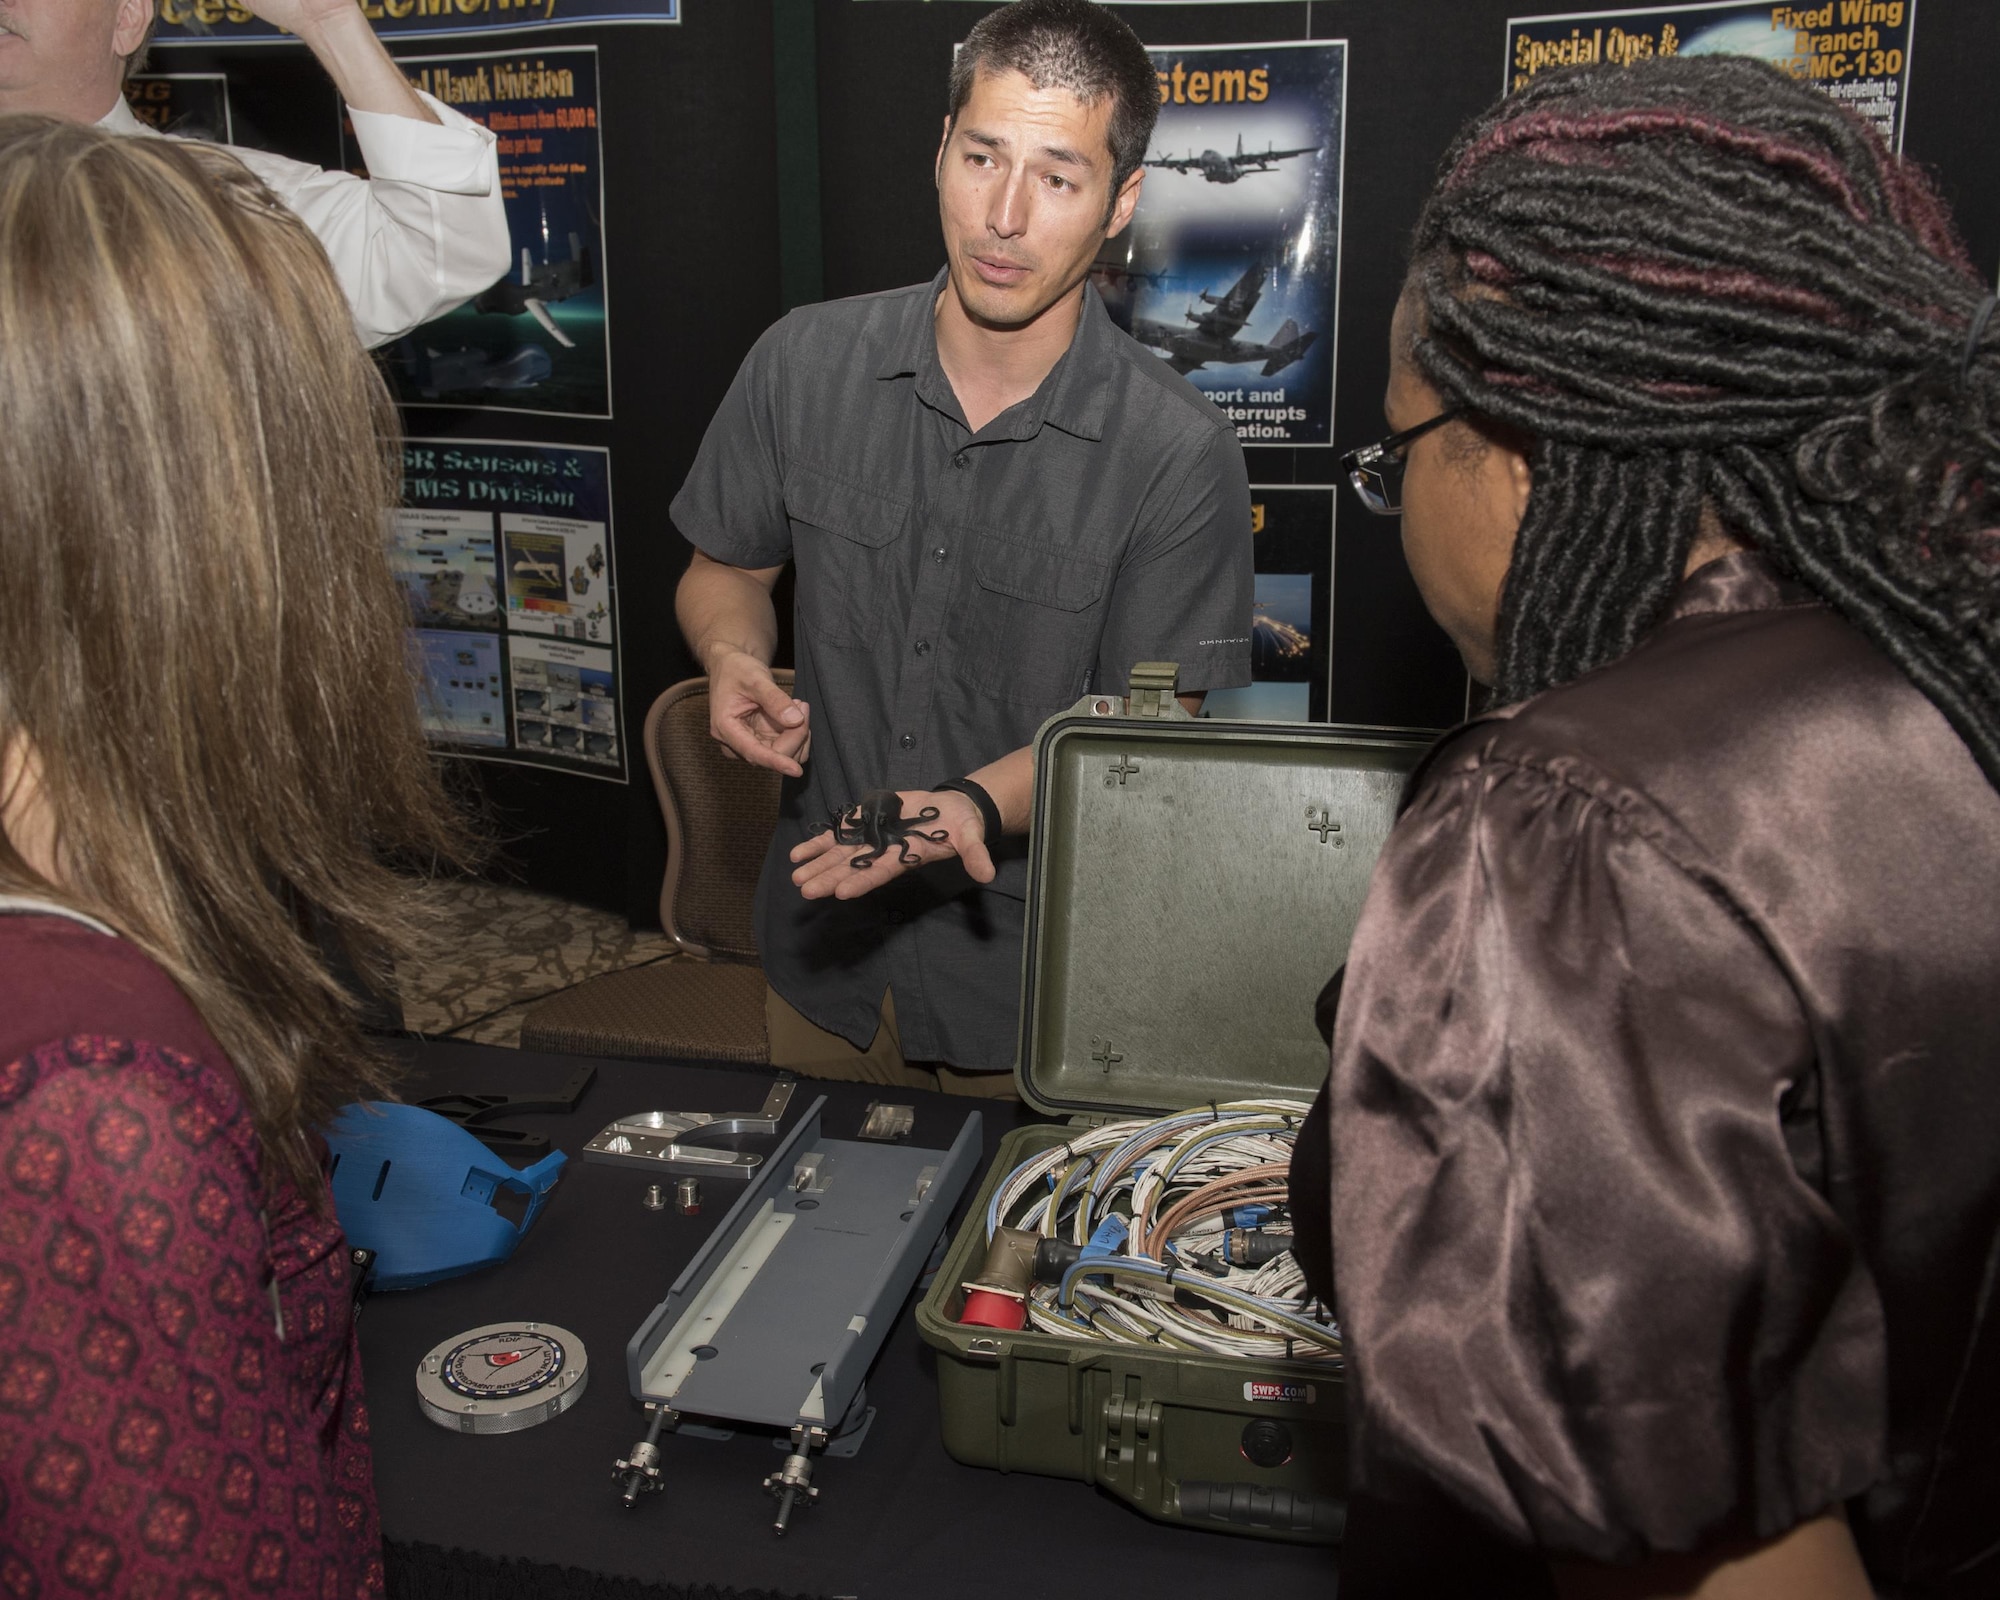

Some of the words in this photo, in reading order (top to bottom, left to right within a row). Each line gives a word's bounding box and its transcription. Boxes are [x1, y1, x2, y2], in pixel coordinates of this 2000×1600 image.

[1771, 2, 1834, 31] Fixed
[1840, 0, 1904, 27] Wing
[1515, 28, 1602, 75] Special
[1606, 27, 1653, 68] Ops
[1658, 23, 1679, 57] &
[1794, 25, 1879, 54] Branch
[434, 66, 491, 103] Hawk
[494, 60, 574, 101] Division
[1886, 78, 1898, 97] to
[1248, 388, 1285, 402] and
[1236, 423, 1292, 438] ation.
[442, 450, 557, 476] Sensors
[562, 456, 583, 478] &
[467, 480, 575, 507] Division
[1252, 1384, 1306, 1398] SWPS.COM
